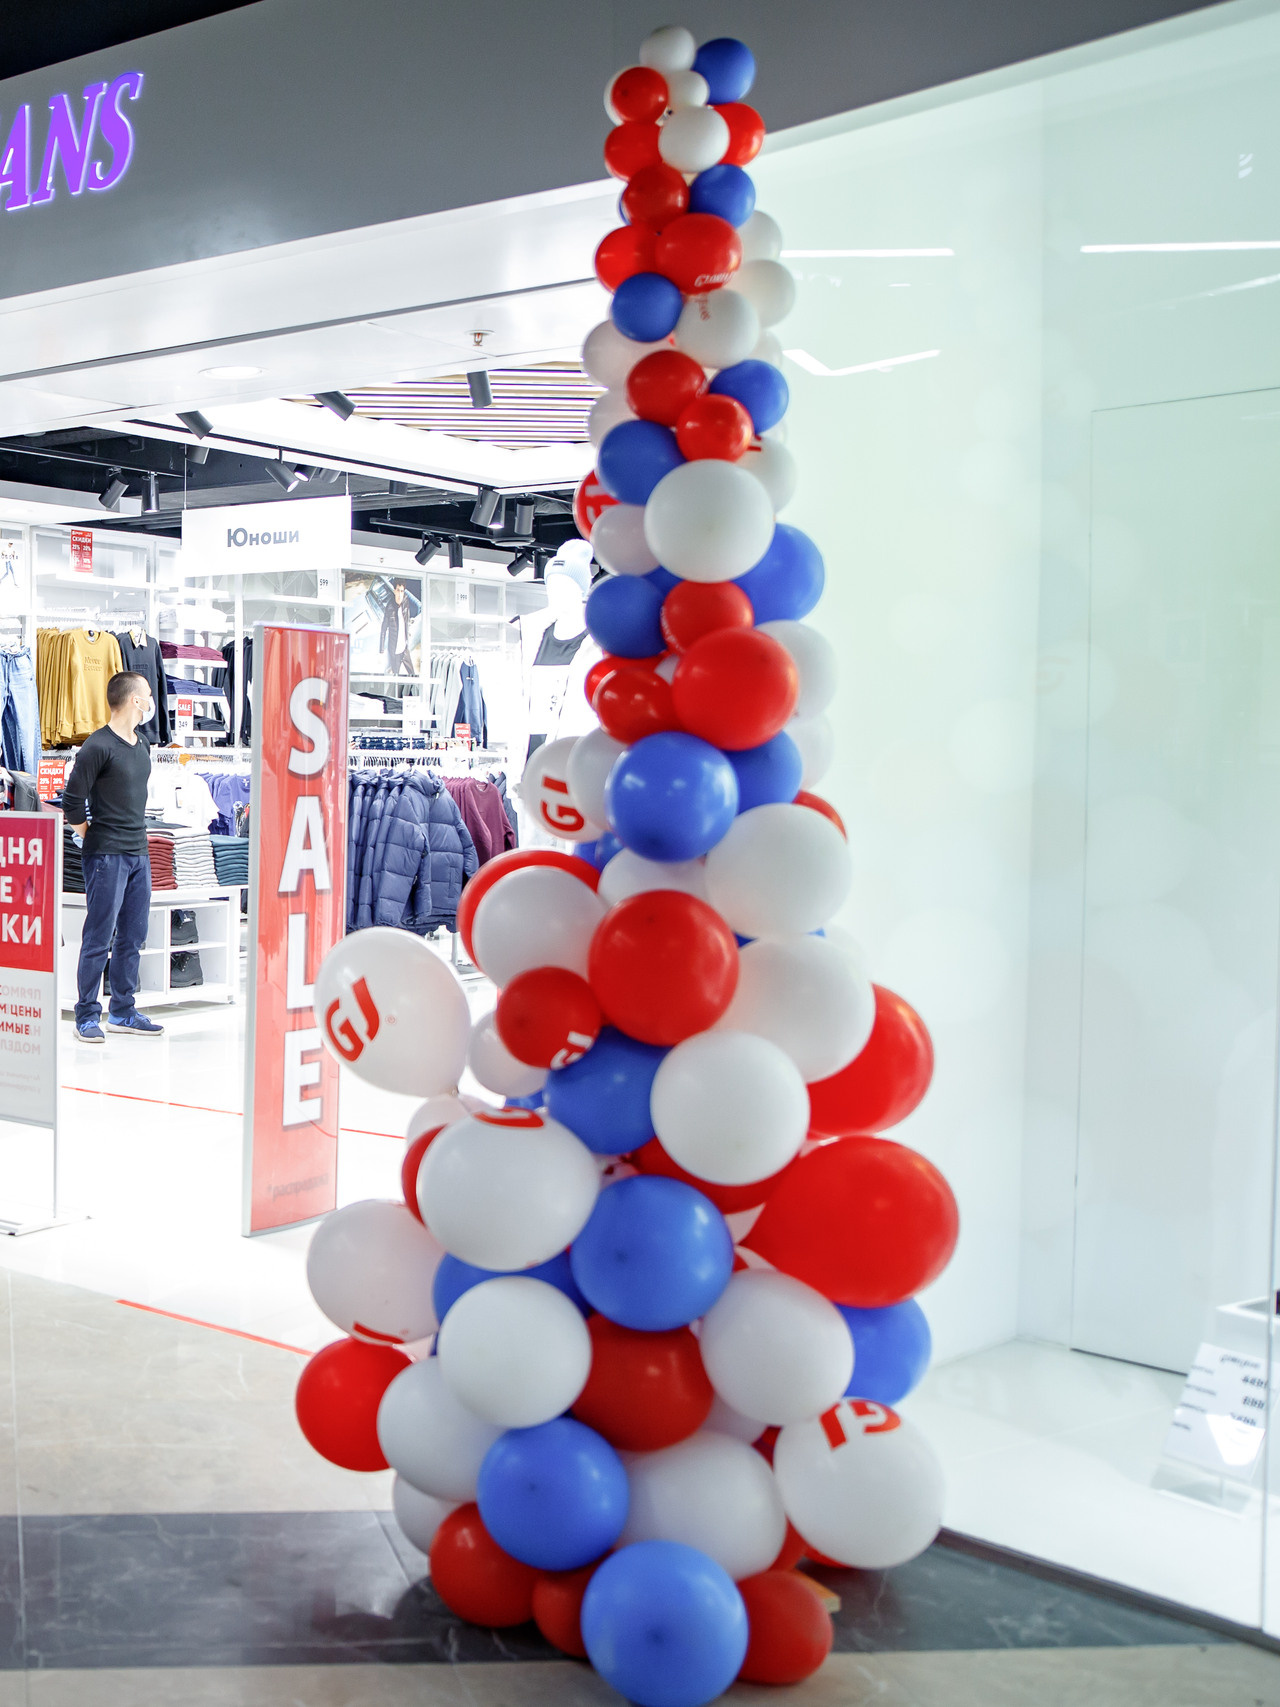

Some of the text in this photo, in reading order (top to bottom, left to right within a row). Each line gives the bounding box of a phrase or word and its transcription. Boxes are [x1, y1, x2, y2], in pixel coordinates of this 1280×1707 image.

[227, 527, 299, 548] Юноши
[277, 676, 332, 1130] SALE
[10, 1004, 42, 1019] ЦЕНЫ
[325, 976, 380, 1063] GJ
